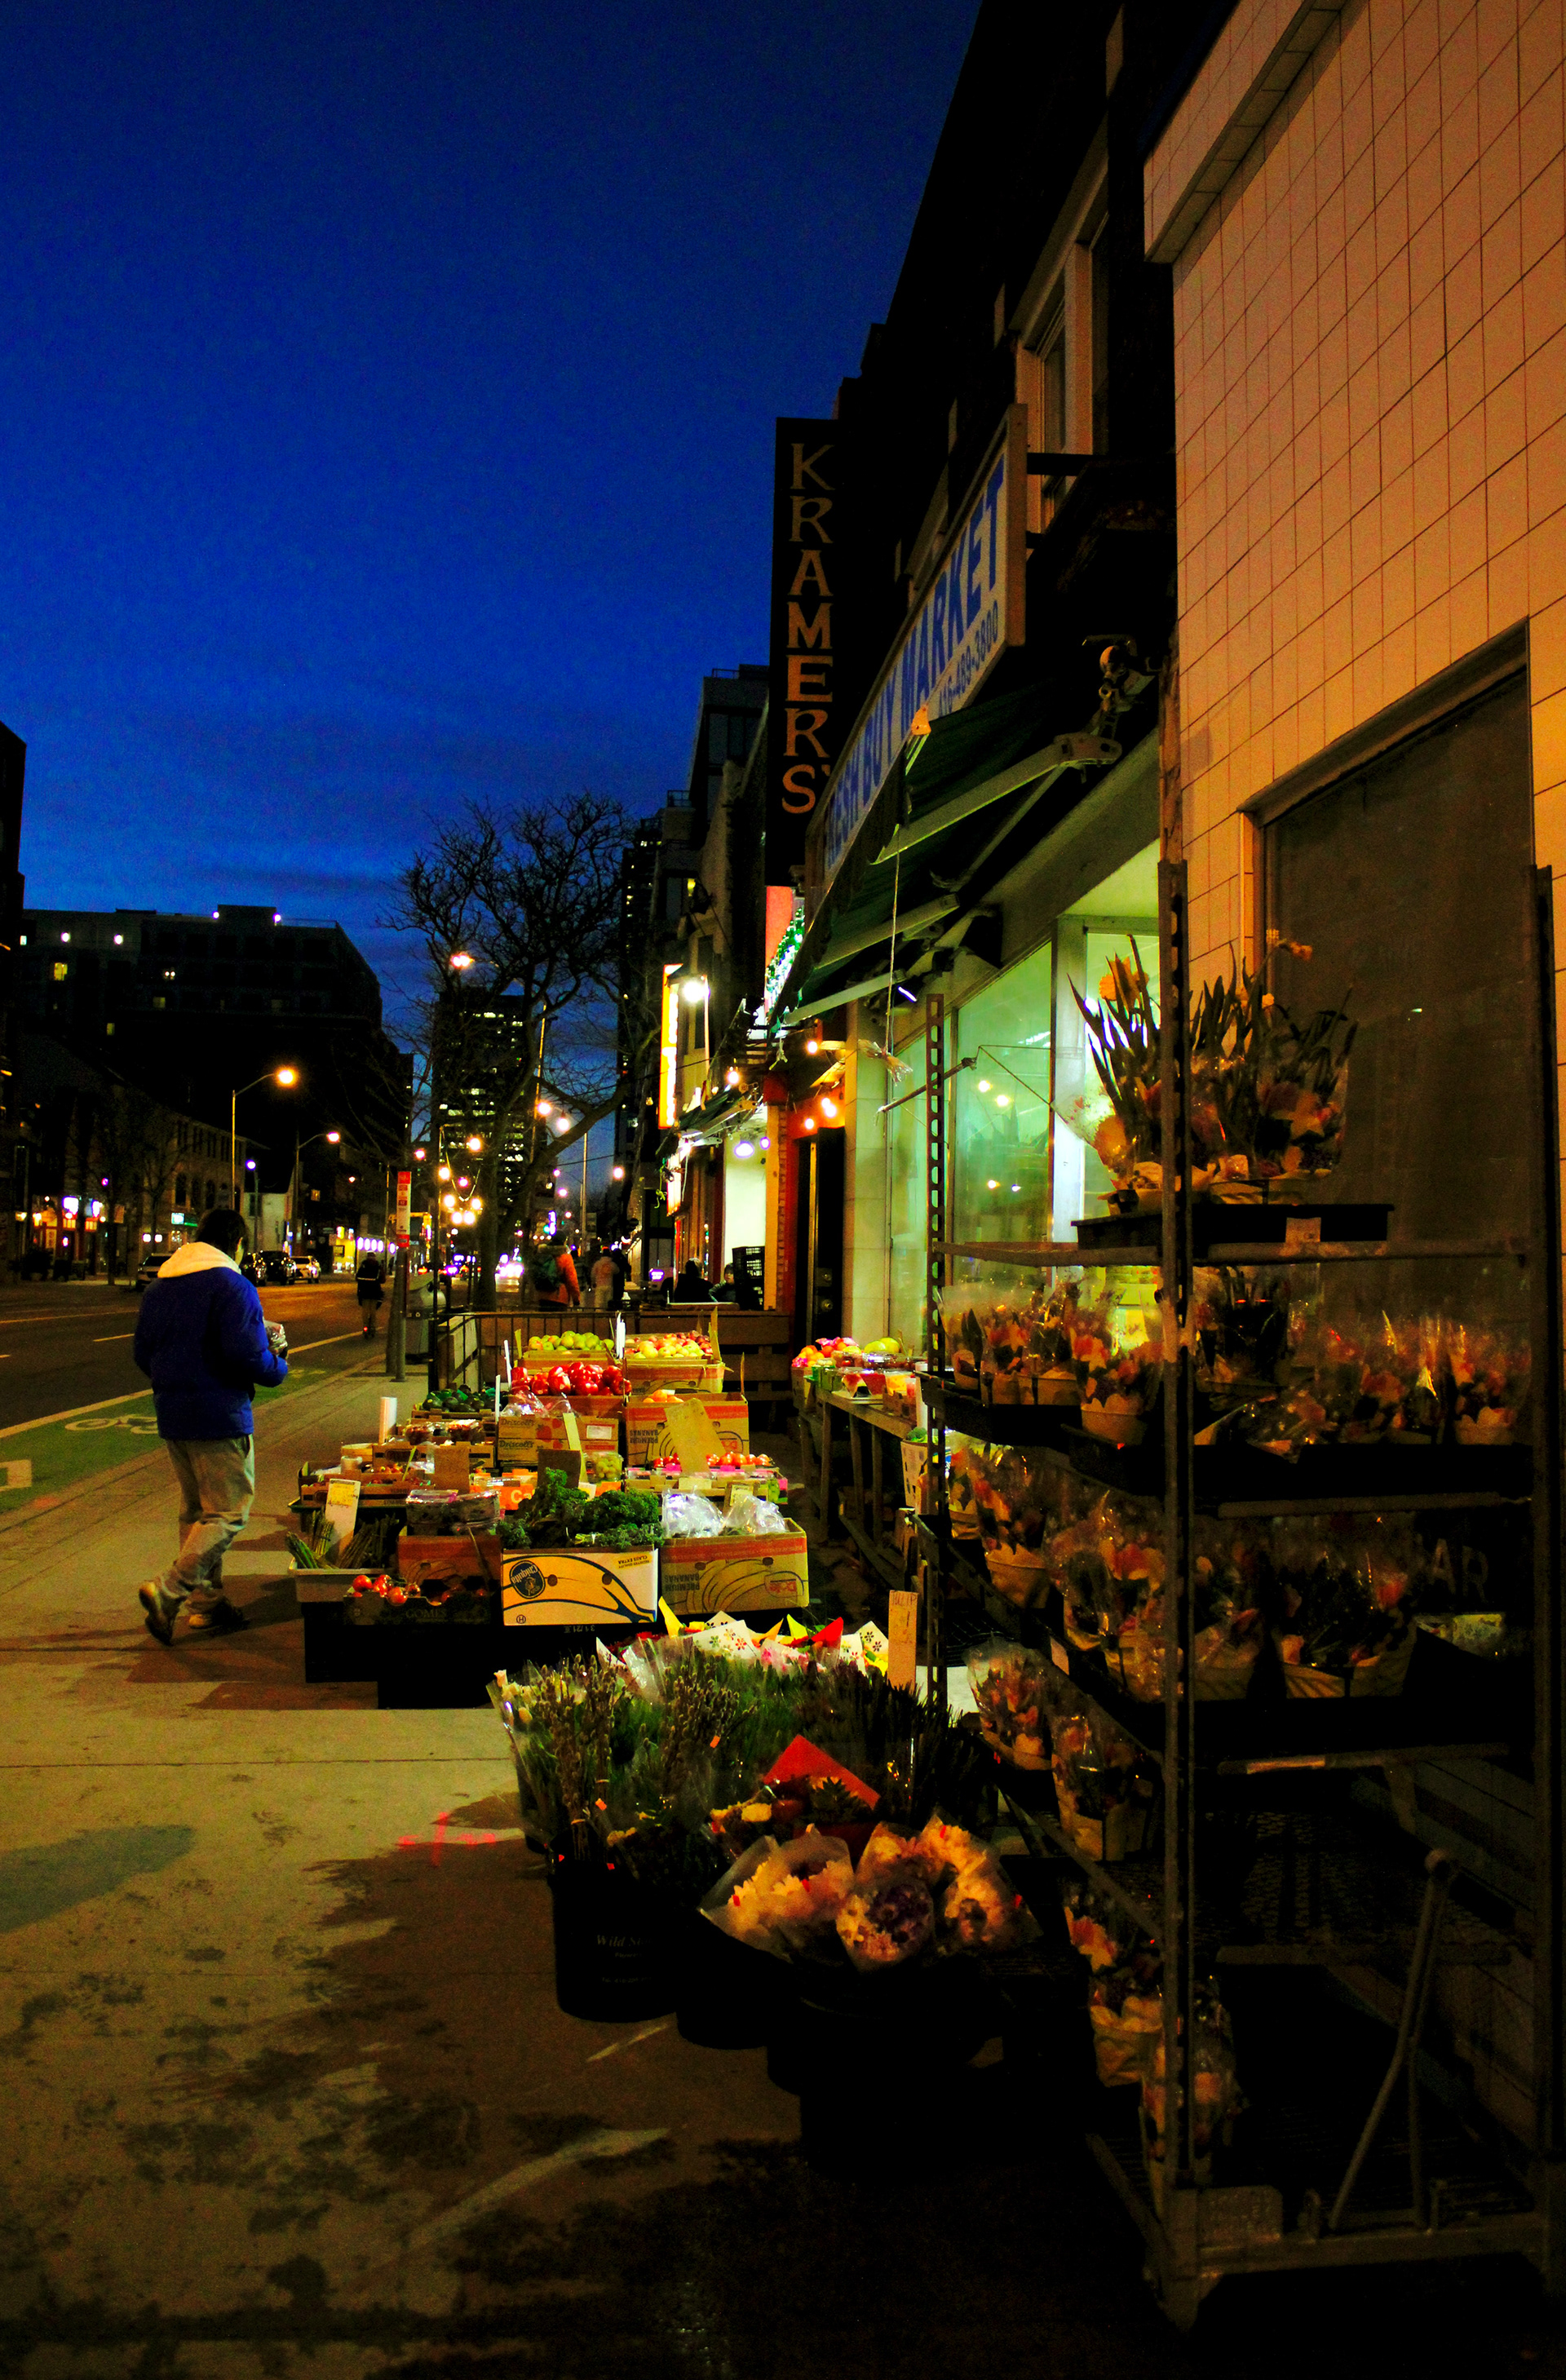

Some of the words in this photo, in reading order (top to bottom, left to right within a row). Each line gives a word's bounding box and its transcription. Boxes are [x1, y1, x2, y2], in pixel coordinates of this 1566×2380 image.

[863, 666, 897, 806] BUY
[900, 453, 1004, 741] MARKET
[511, 1564, 538, 1584] Chiquita
[665, 1573, 699, 1582] BANANAS
